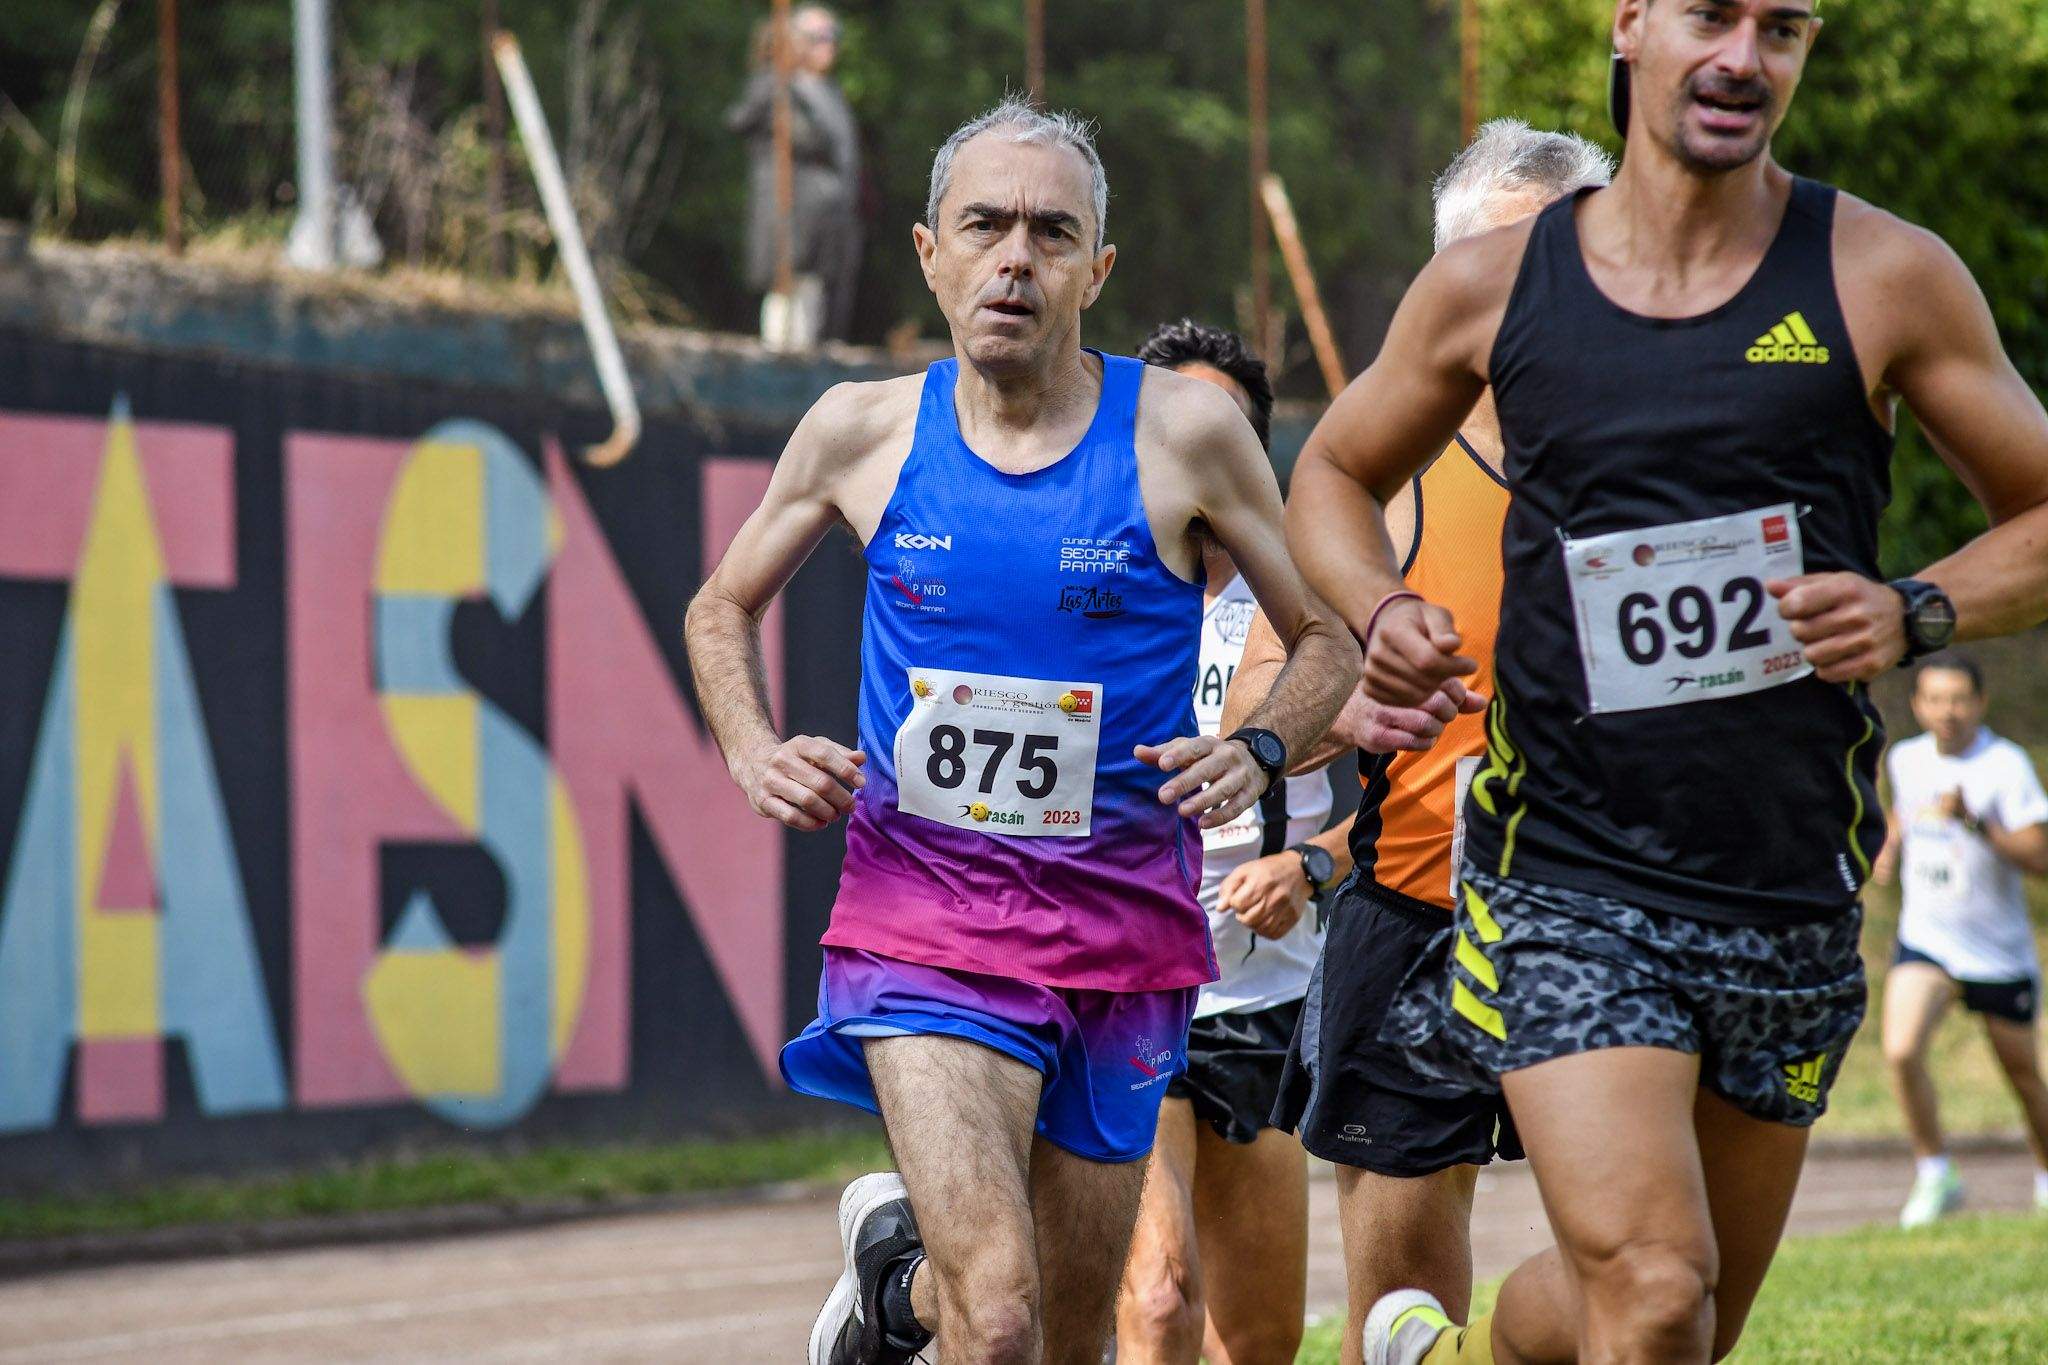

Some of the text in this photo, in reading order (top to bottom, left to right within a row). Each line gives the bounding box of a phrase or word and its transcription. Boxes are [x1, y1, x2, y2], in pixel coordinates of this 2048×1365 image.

[1745, 343, 1831, 365] adidas
[895, 533, 952, 550] KON
[1057, 585, 1122, 612] Las Artes
[1617, 575, 1772, 666] 692
[1761, 652, 1803, 676] 2023
[974, 688, 1028, 699] RIESGO
[926, 724, 1059, 800] 875
[1042, 810, 1081, 825] 2023
